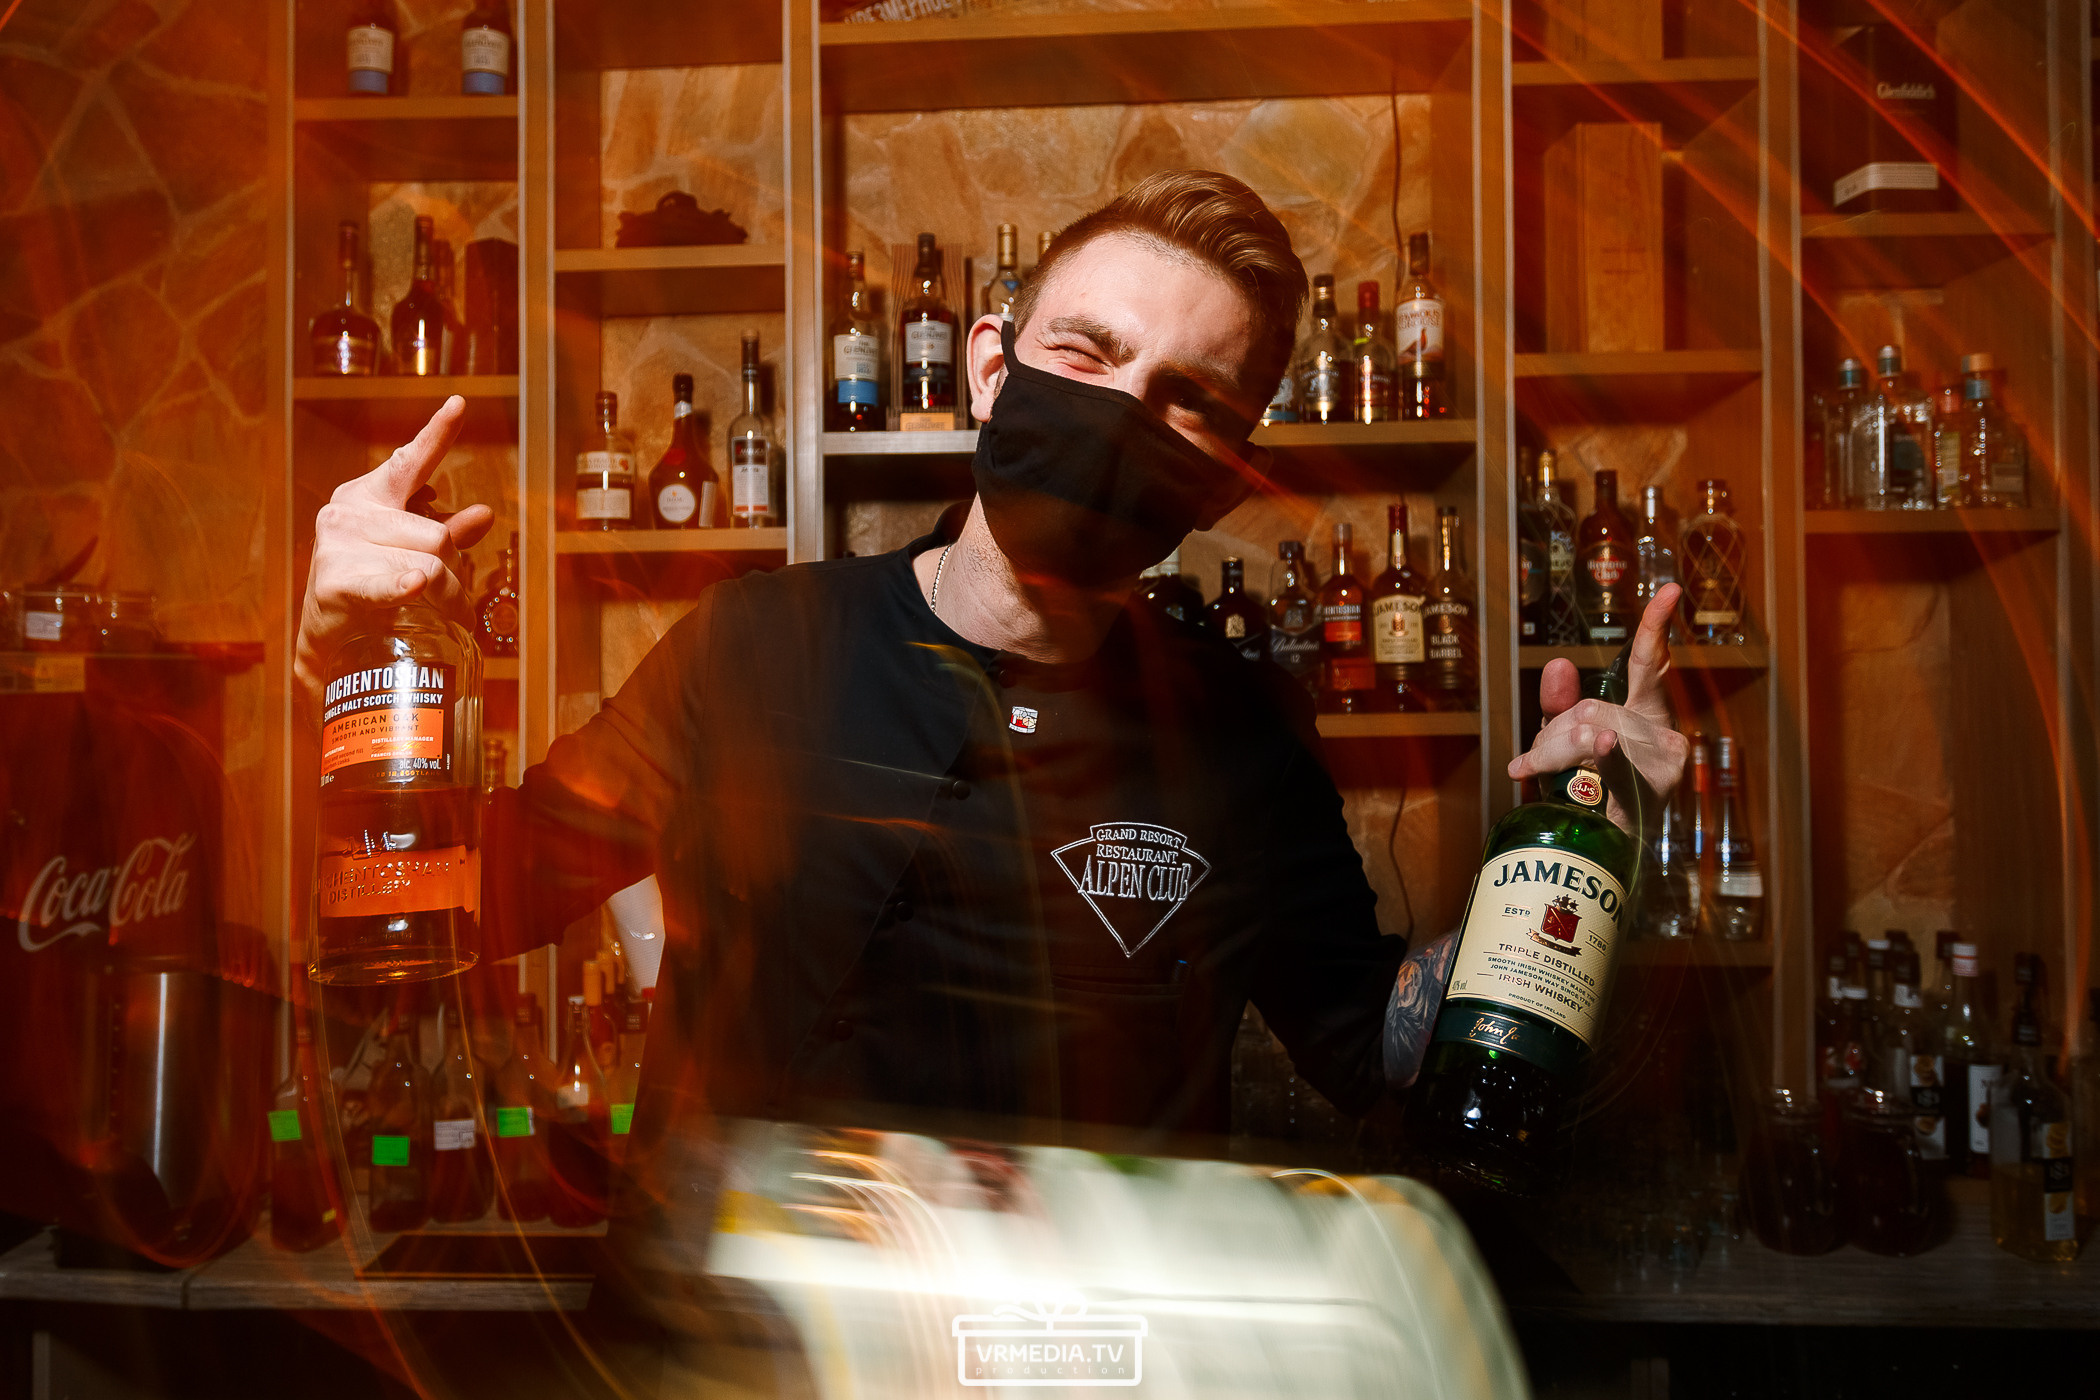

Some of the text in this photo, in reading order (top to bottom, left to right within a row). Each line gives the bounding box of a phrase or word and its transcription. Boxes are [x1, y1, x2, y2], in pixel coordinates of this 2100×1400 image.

[324, 666, 444, 708] AUCHENTOSHAN
[341, 698, 363, 713] MALT
[363, 693, 401, 708] SCOTCH
[331, 714, 388, 735] AMERICAN
[331, 731, 358, 745] SMOOTH
[359, 727, 377, 736] AND
[399, 758, 411, 770] alc.
[412, 757, 429, 770] 40%
[429, 758, 442, 770] vol.
[1096, 828, 1182, 850] GRAND RESORT
[1095, 843, 1179, 865] RESTAURANT
[1077, 854, 1193, 902] ALPEN CLUB
[17, 832, 199, 953] Coca-Cola
[1588, 934, 1607, 952] 1780
[1487, 956, 1516, 966] SMOOTH
[1517, 961, 1537, 972] IRISH
[1538, 967, 1570, 986] WHISKEY
[1569, 981, 1587, 996] MADE
[1498, 943, 1541, 960] TRIPLE
[1543, 954, 1596, 987] DISTILLED
[1490, 963, 1509, 971] JOHN
[1509, 966, 1544, 982] JAMESON
[1544, 978, 1560, 989] WAY
[1560, 985, 1579, 1000] SINCE
[1498, 972, 1584, 1014] IRISH WHISKEY
[1508, 992, 1536, 1006] PRODUCT
[1543, 1005, 1568, 1020] IRELAND
